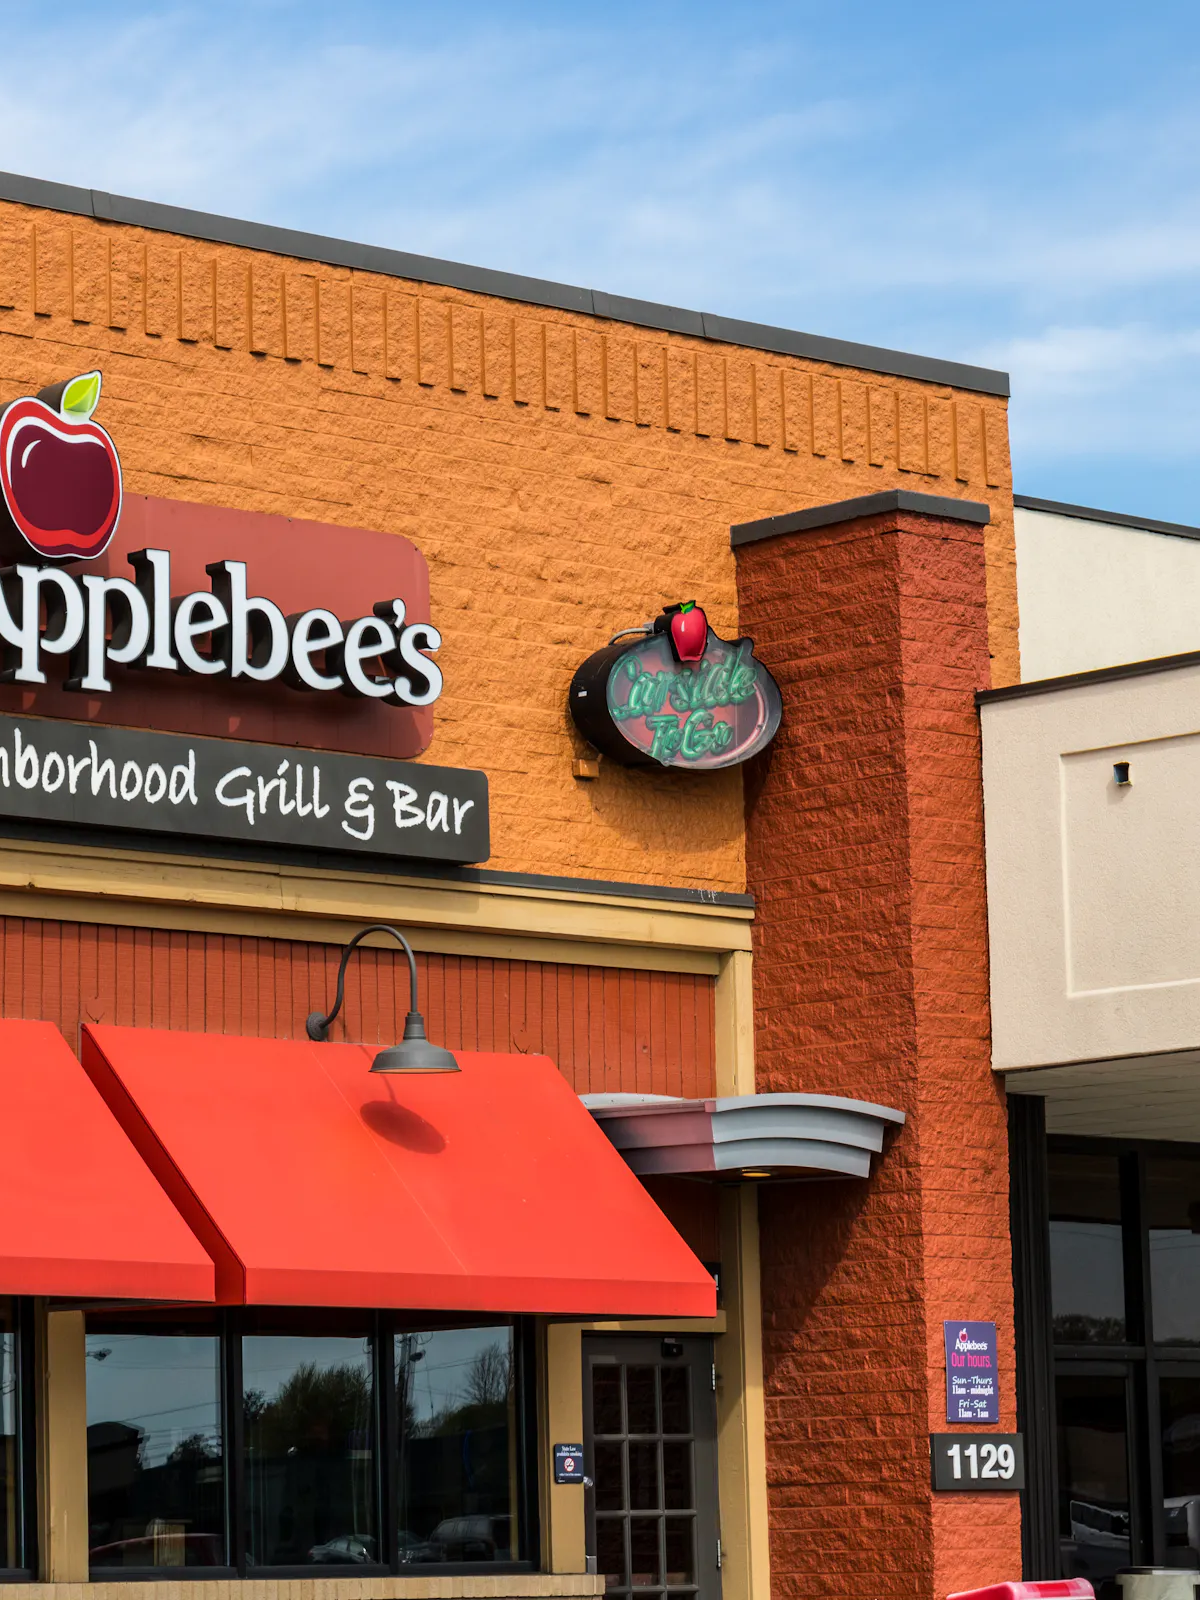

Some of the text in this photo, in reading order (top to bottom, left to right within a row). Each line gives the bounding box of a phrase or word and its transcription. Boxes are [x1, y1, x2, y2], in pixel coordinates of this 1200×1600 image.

[681, 709, 733, 759] Go
[214, 758, 331, 826] Grill
[341, 776, 377, 842] &
[385, 779, 476, 836] Bar
[955, 1339, 988, 1352] Applebee's
[951, 1352, 992, 1368] Our hours.
[970, 1386, 994, 1396] midnight
[947, 1443, 1016, 1480] 1129
